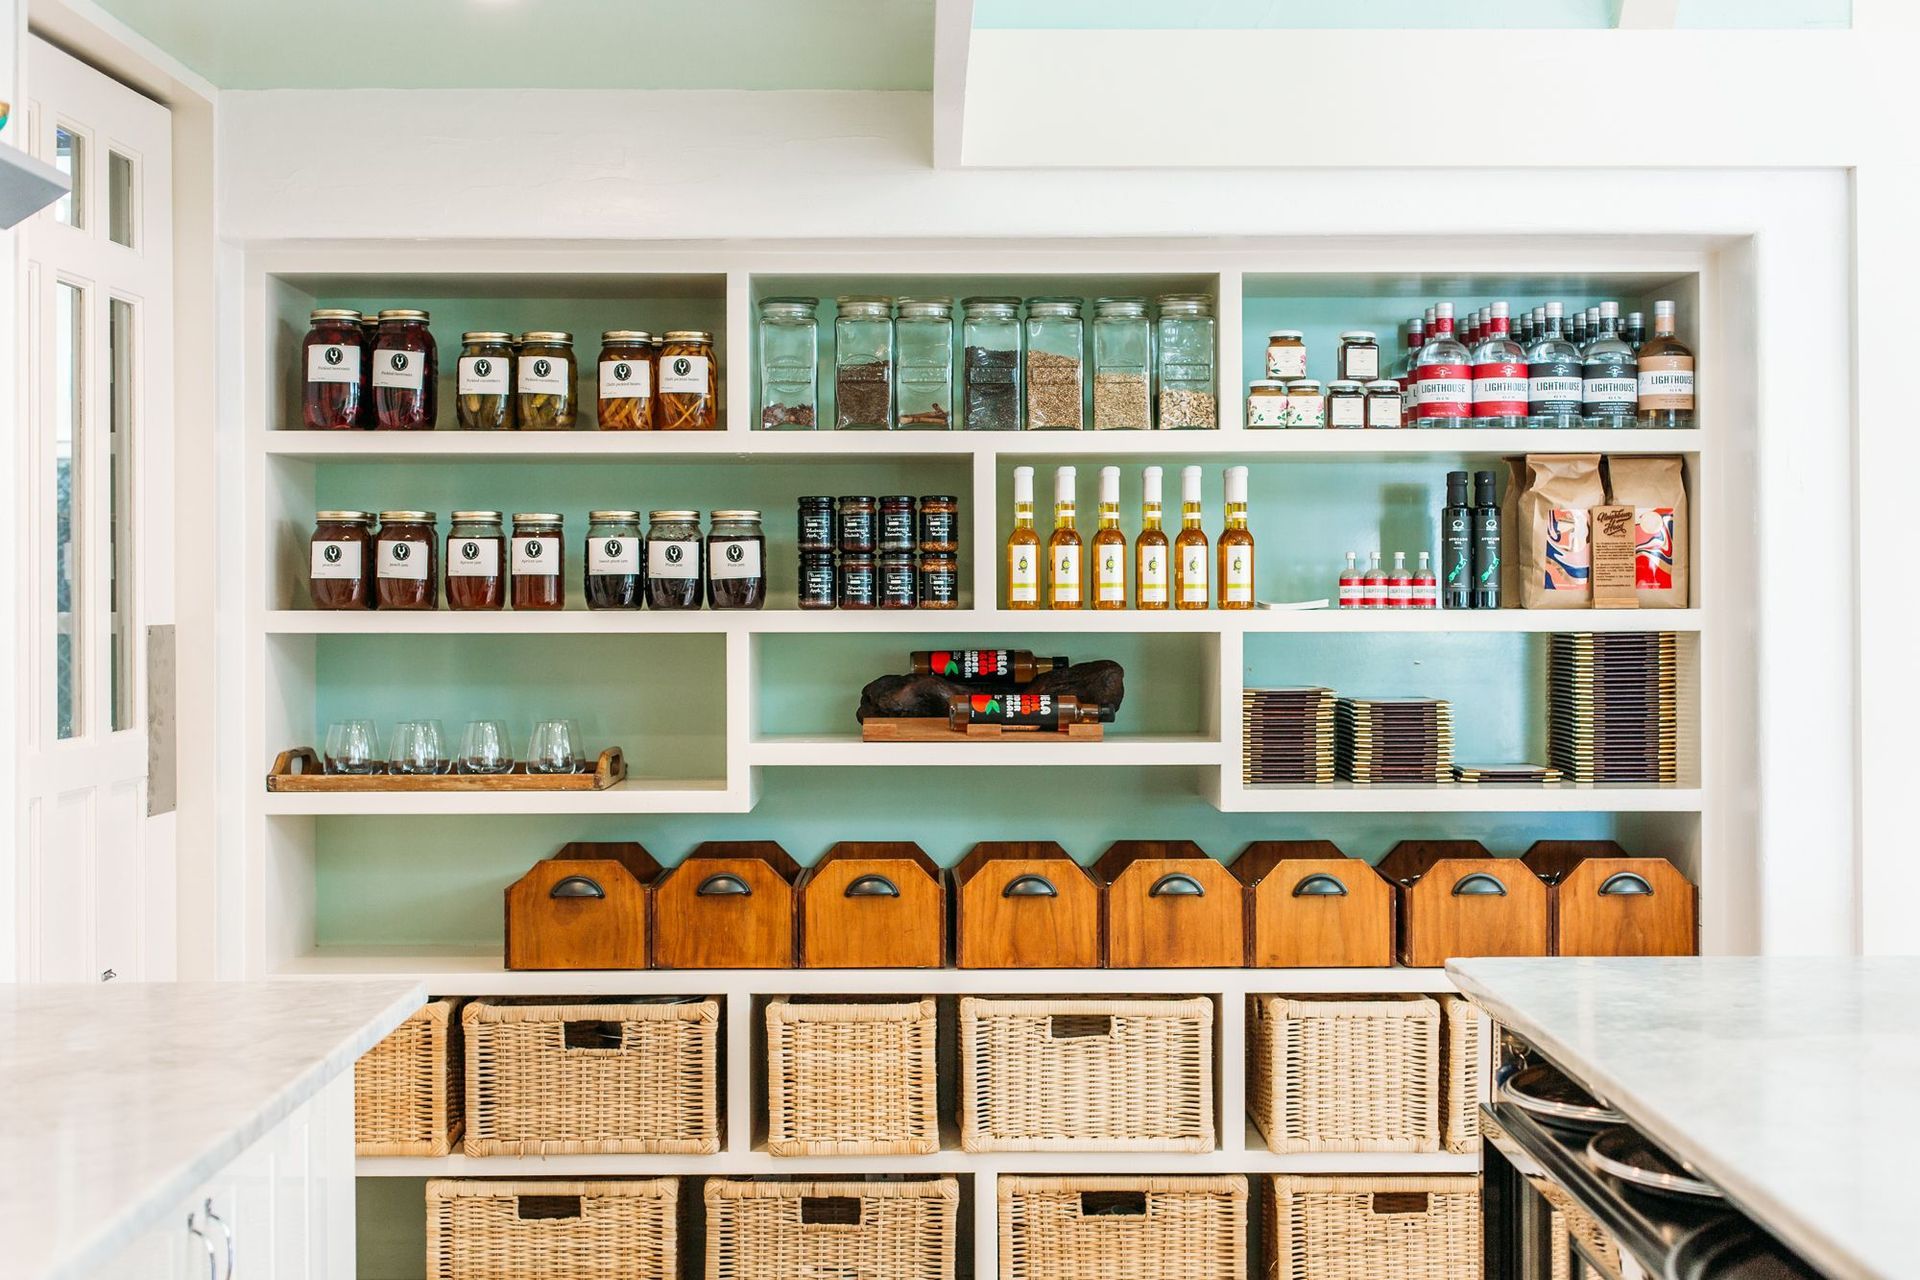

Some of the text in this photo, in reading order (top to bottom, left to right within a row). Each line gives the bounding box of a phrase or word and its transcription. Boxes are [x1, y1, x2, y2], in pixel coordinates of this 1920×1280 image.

[1651, 375, 1693, 385] LIGHTHOUSE
[1421, 383, 1466, 394] LIGHTHOUSE
[1484, 382, 1527, 392] LIGHTHOUSE
[1536, 381, 1580, 392] LIGHTHOUSE
[1591, 383, 1635, 393] LIGHTHOUSE
[1040, 694, 1052, 715] ELA
